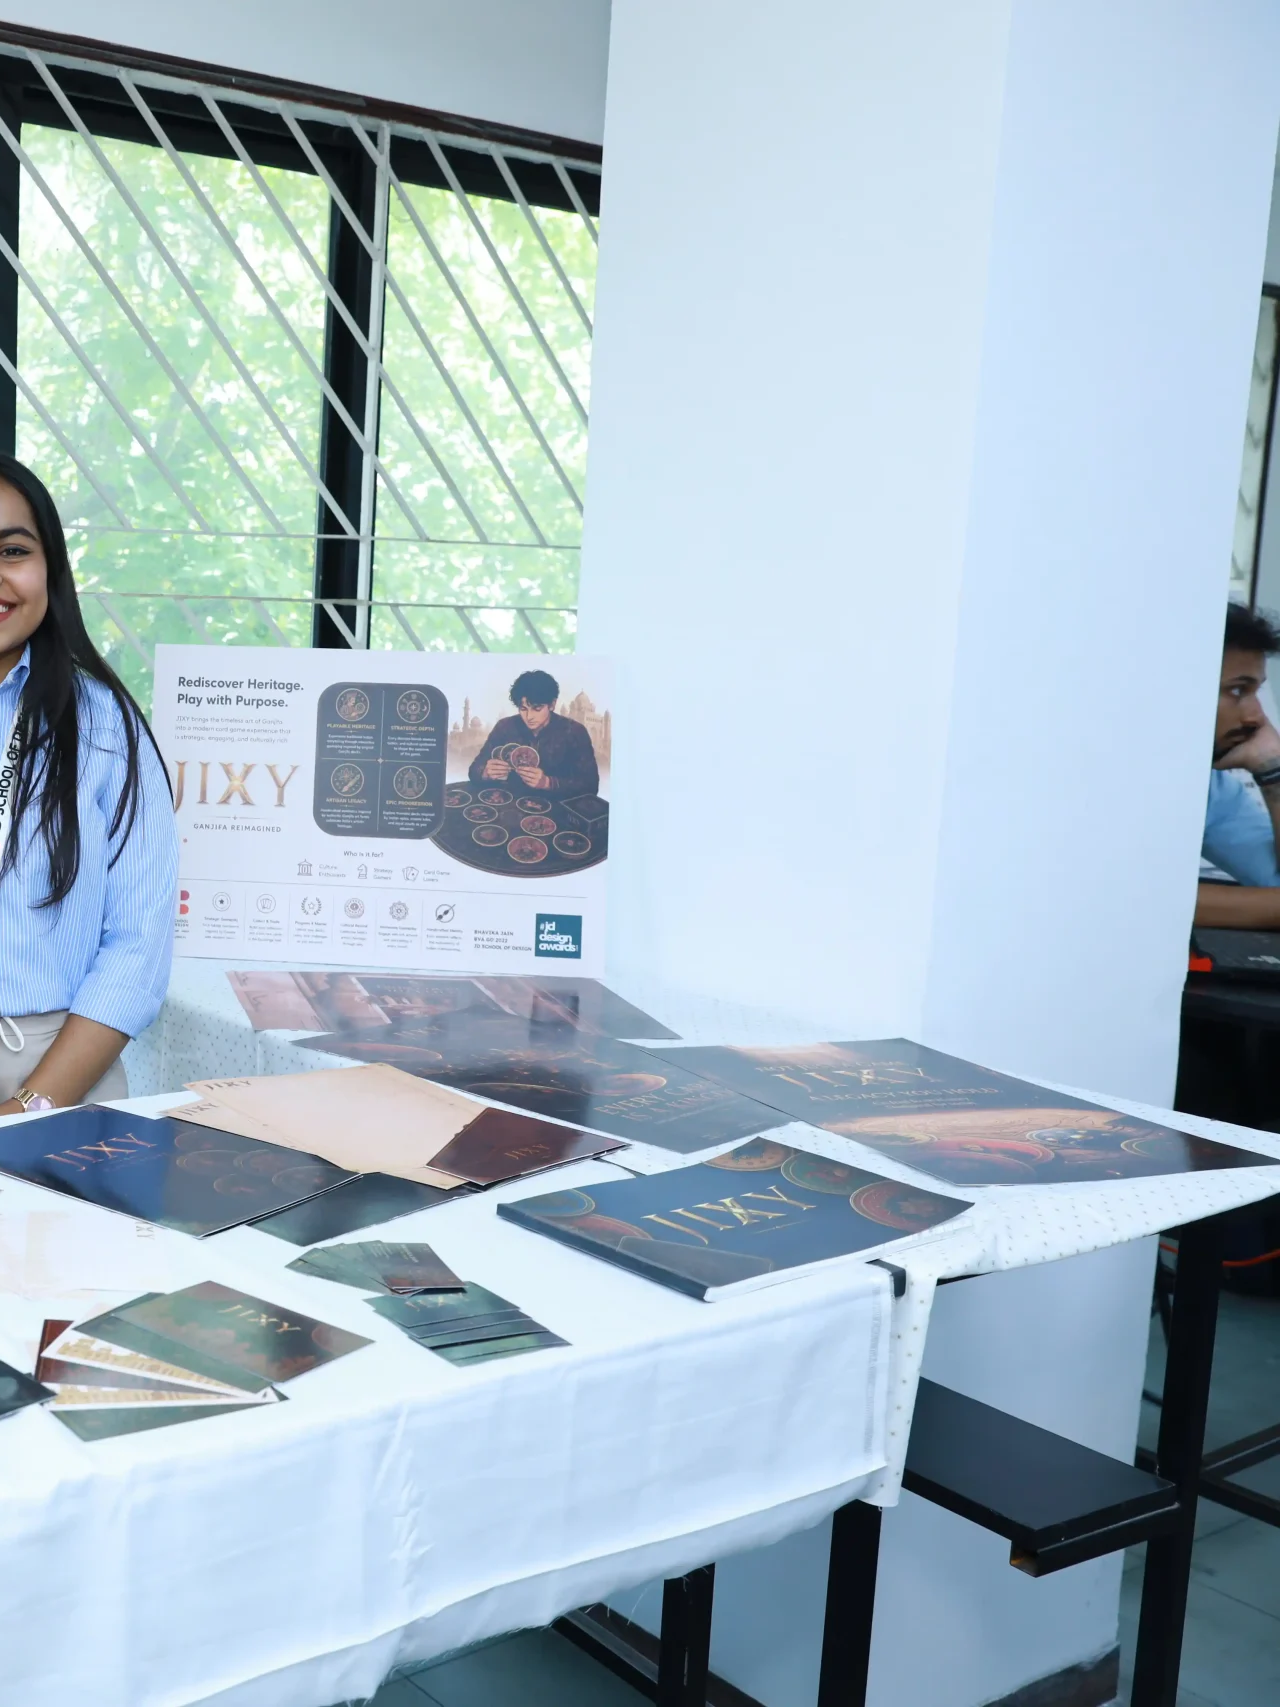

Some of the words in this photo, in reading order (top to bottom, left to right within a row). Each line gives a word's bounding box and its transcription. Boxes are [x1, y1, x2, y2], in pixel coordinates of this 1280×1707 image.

[178, 676, 244, 689] Rediscover
[247, 678, 304, 693] Heritage.
[177, 693, 203, 707] Play
[206, 695, 232, 706] with
[236, 695, 288, 709] Purpose.
[191, 716, 209, 724] brings
[174, 760, 300, 814] JIXY
[193, 823, 228, 831] GANJIFA
[230, 824, 282, 833] REIMAGINED
[539, 932, 573, 944] design
[538, 943, 576, 952] awards
[204, 1080, 252, 1090] JIXY
[177, 1102, 220, 1117] JIXY
[593, 1091, 665, 1116] EVERY
[43, 1132, 159, 1172] JIXY
[504, 1143, 550, 1160] JIXY
[640, 1184, 816, 1246] JIXY
[135, 1221, 155, 1241] IXY
[217, 1304, 302, 1332] JIXY
